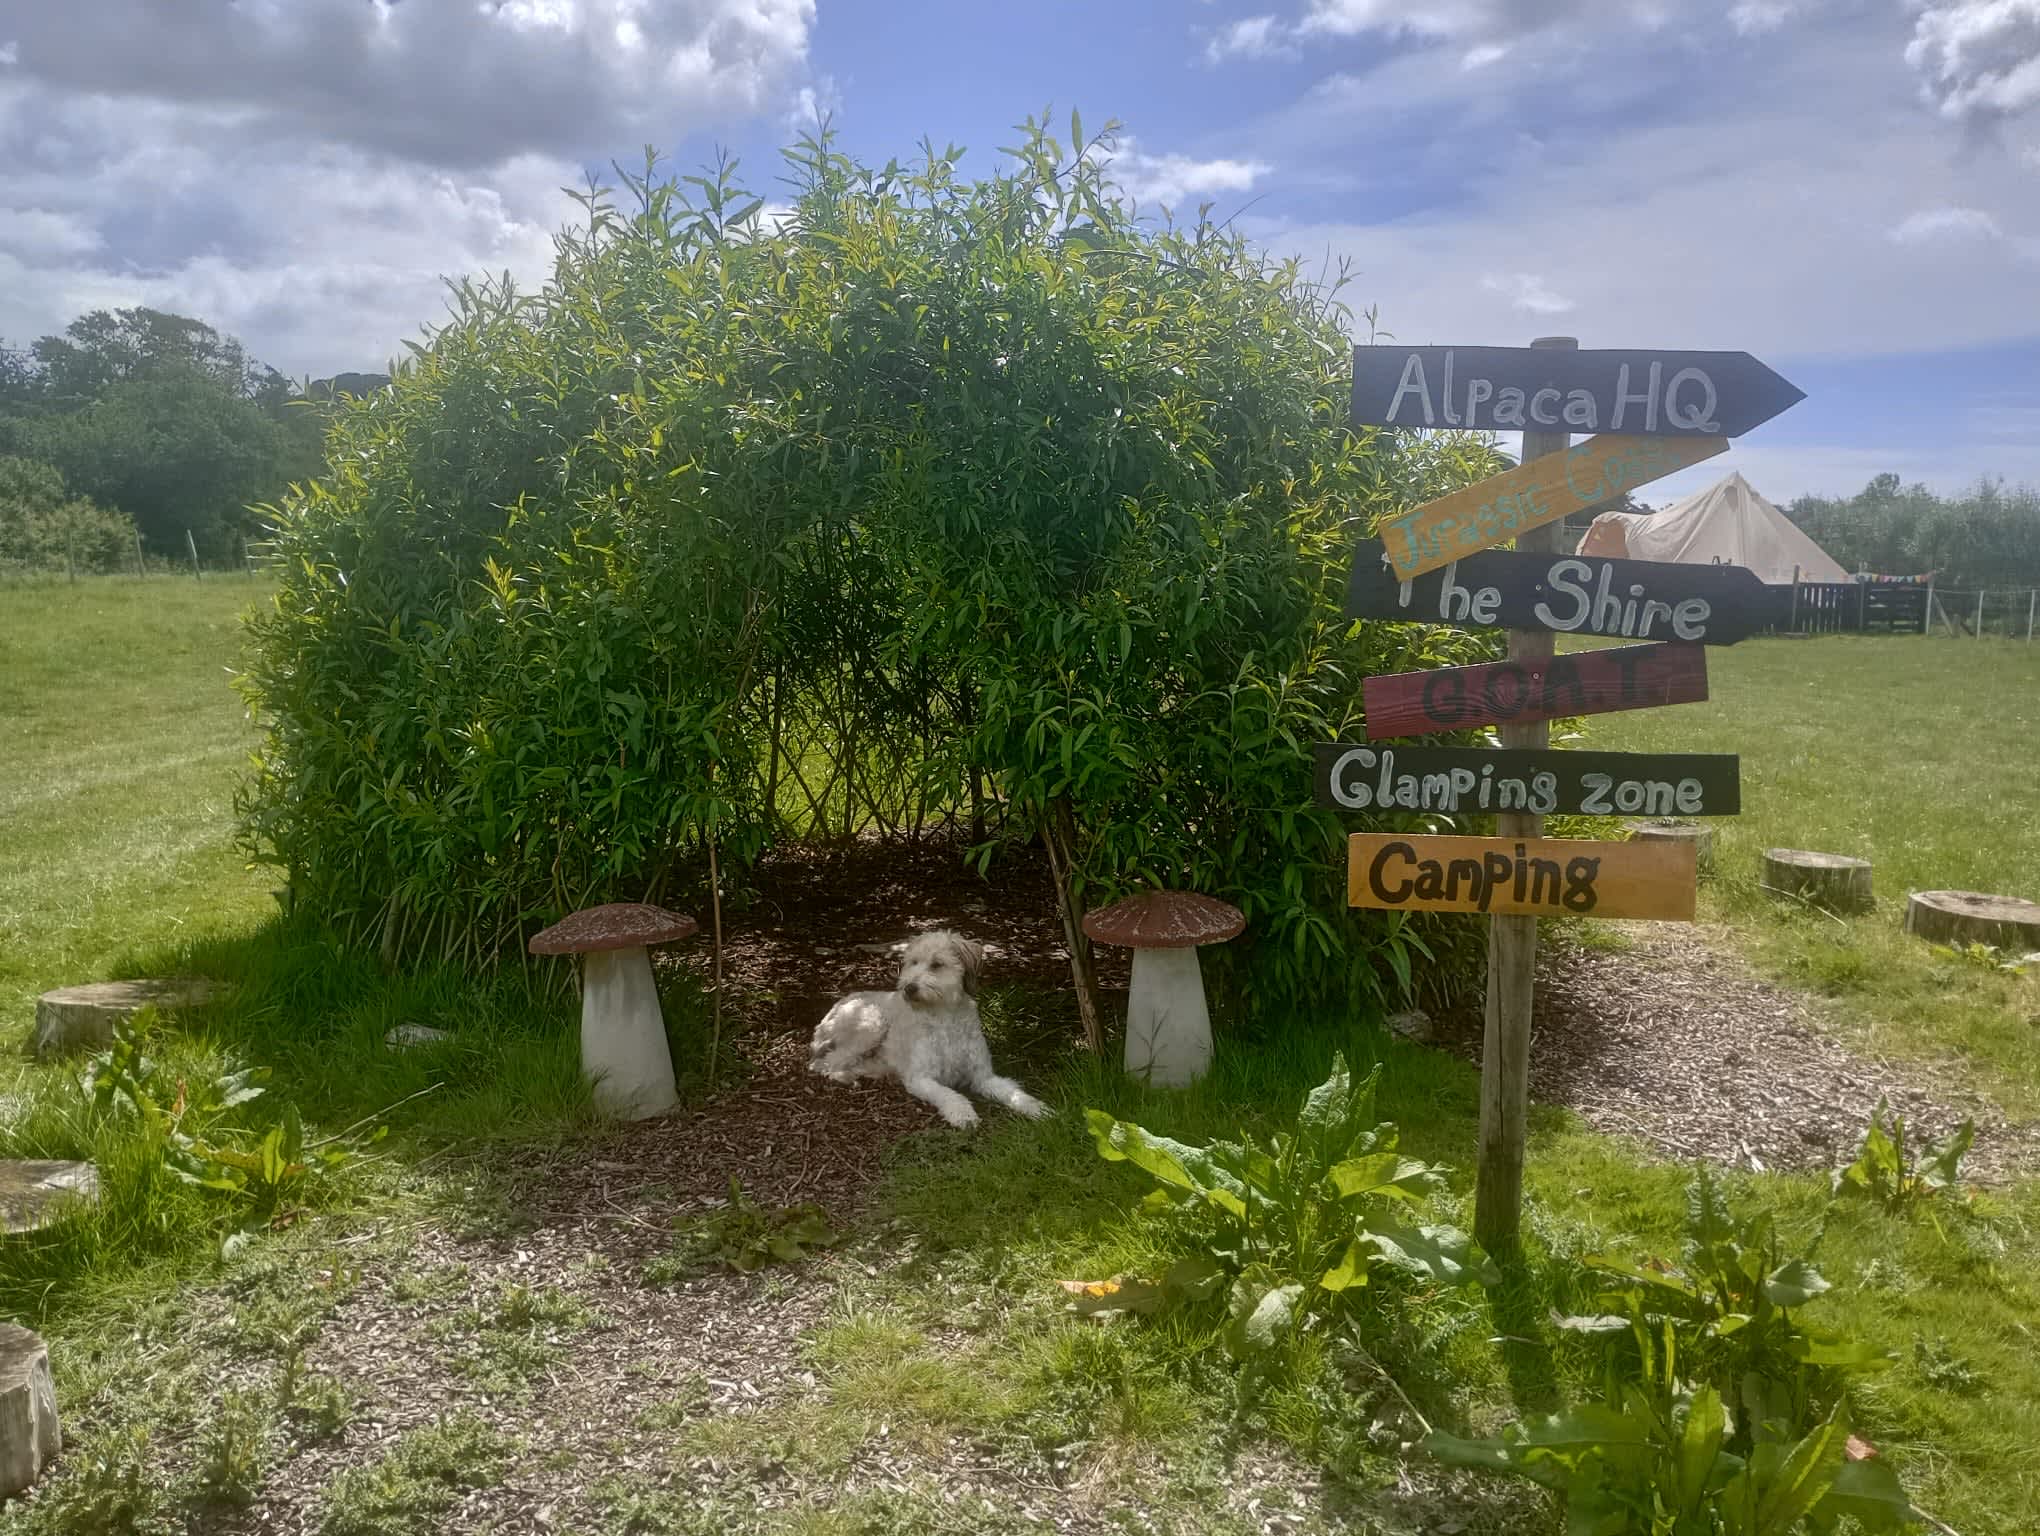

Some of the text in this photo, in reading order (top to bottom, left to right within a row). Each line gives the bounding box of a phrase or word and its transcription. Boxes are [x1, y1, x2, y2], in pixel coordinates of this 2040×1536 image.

[1610, 360, 1721, 433] HQ
[1390, 478, 1551, 571] Jurassic
[1534, 558, 1712, 641] Shire
[1329, 748, 1558, 815] Glamping
[1368, 840, 1602, 914] Camping
